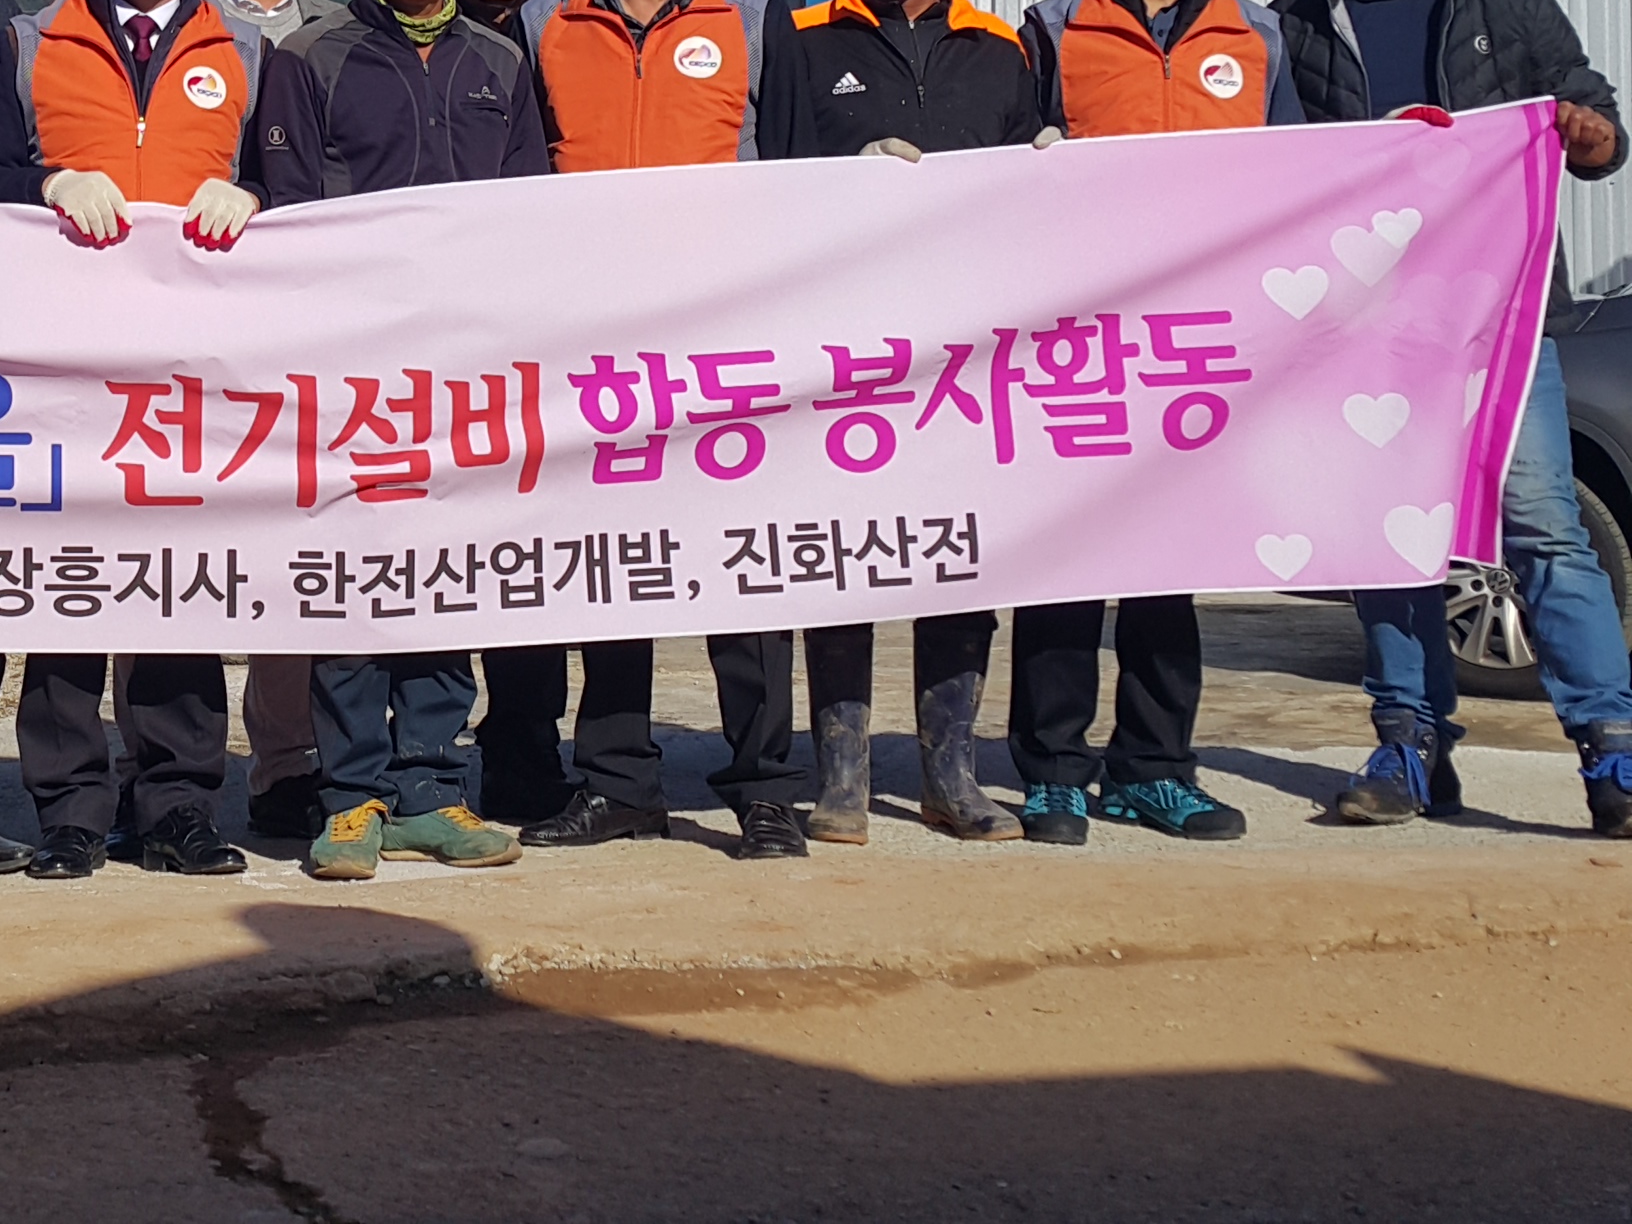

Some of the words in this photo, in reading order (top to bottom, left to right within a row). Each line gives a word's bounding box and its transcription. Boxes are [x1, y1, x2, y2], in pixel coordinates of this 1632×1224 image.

[101, 362, 545, 508] 전기설비
[567, 351, 792, 484] 합동
[812, 310, 1253, 473] 봉사활동
[288, 528, 701, 619] 한전산업개발,
[722, 512, 980, 595] 진화산전
